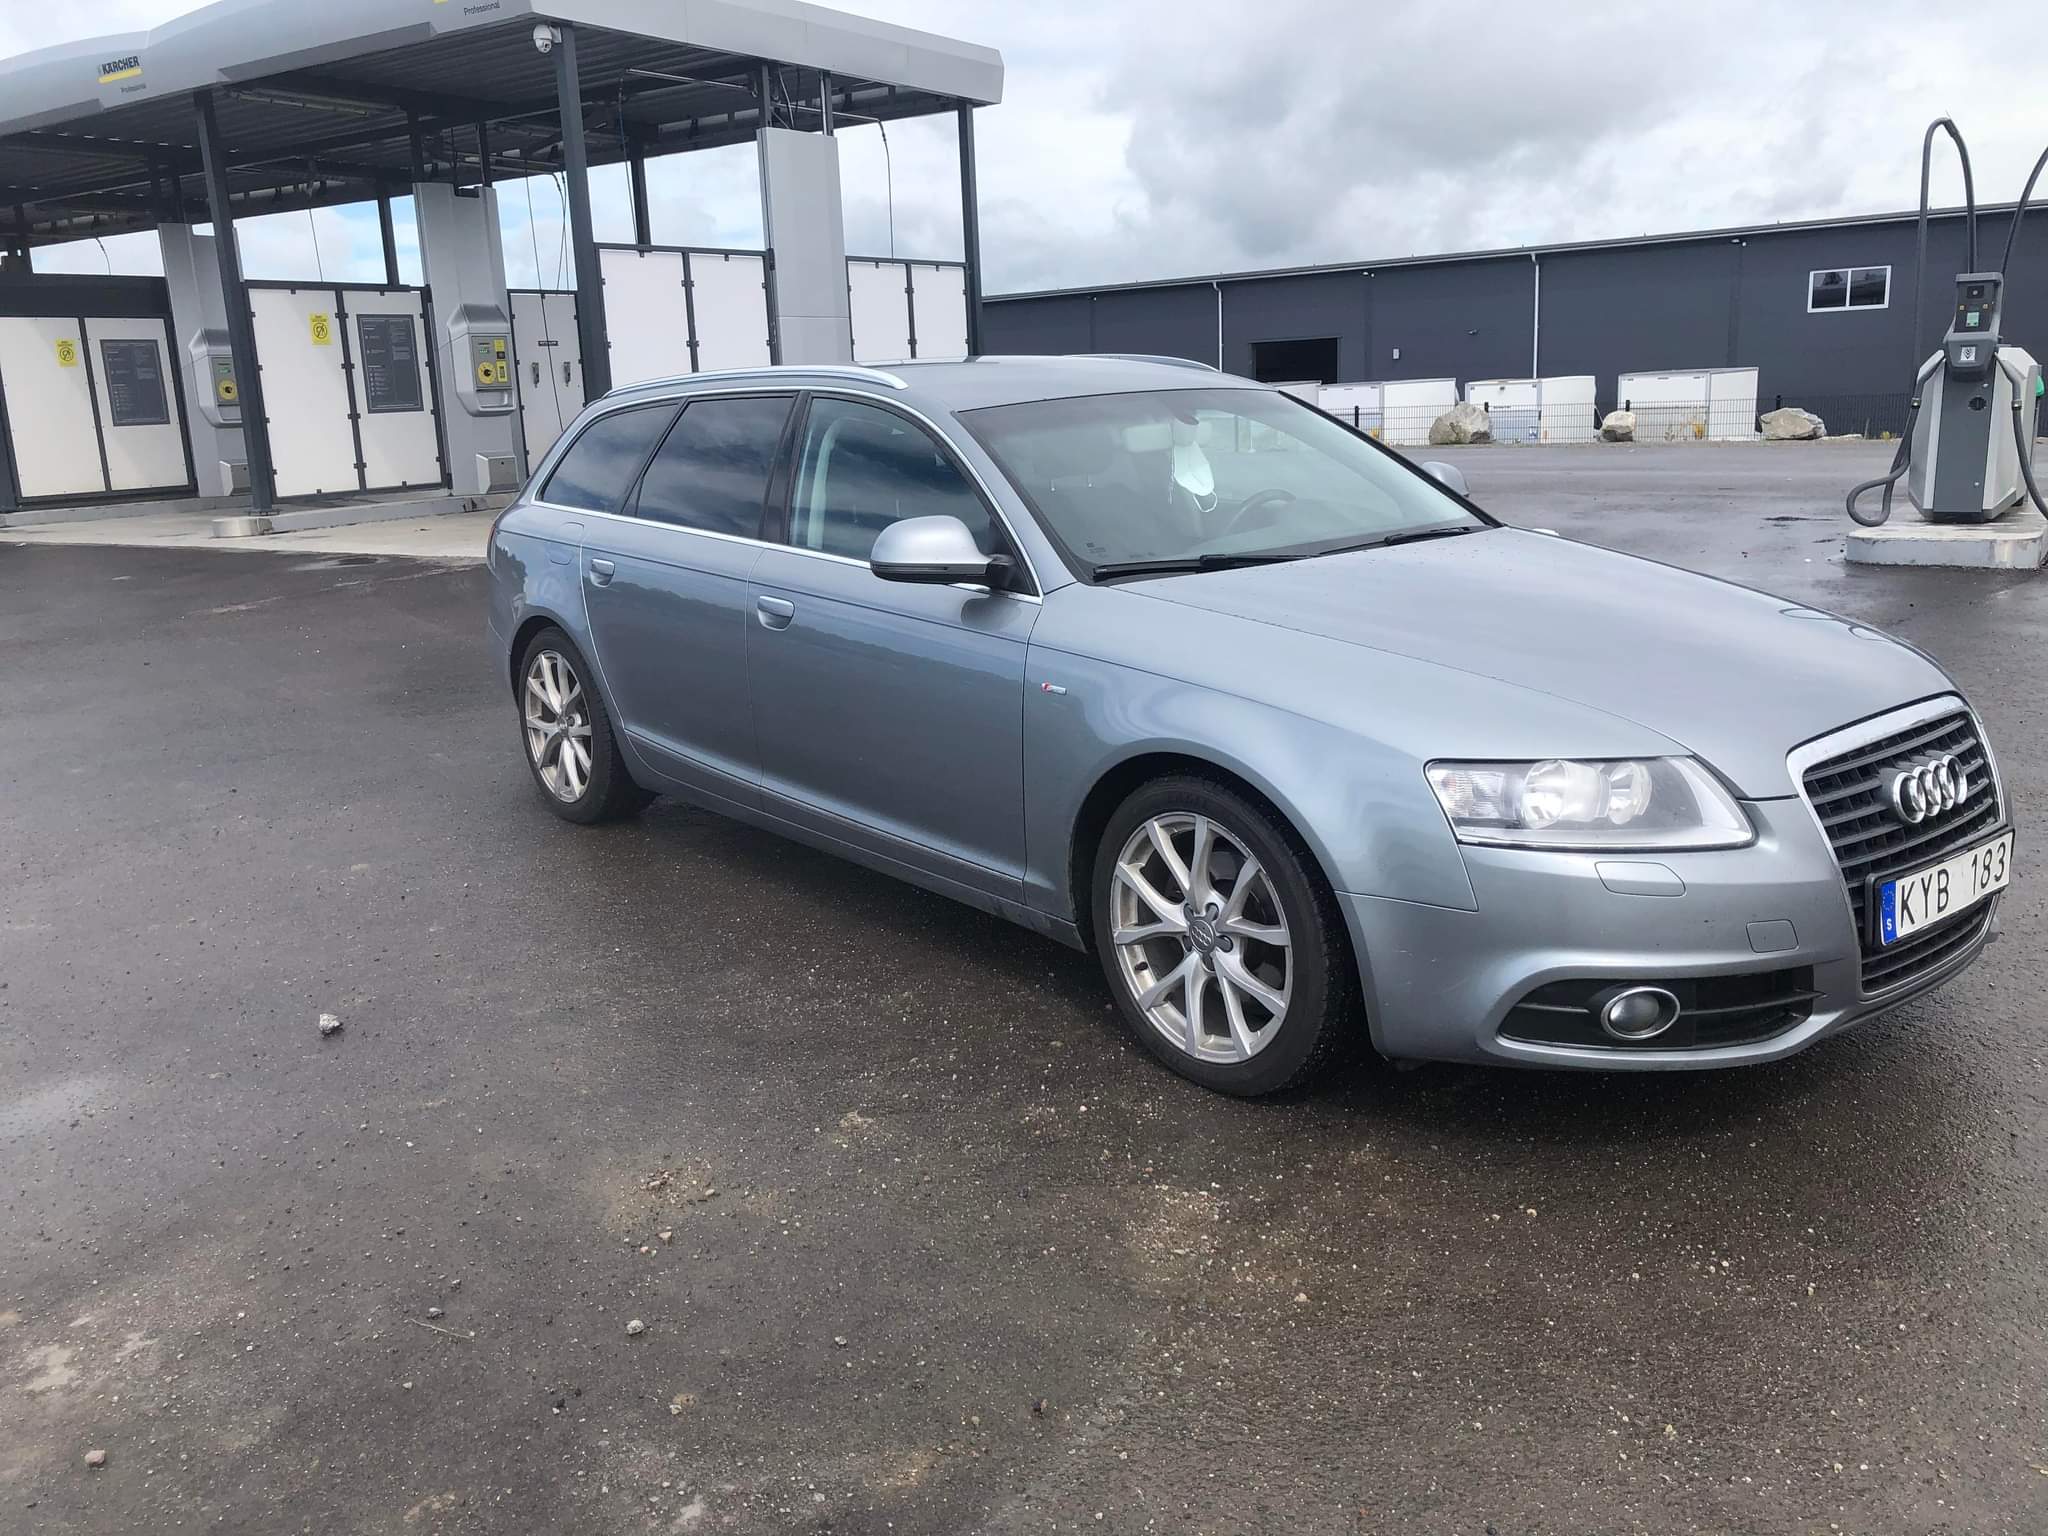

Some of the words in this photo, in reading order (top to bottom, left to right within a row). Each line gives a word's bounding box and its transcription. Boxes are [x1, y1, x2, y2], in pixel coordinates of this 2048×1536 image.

[463, 0, 501, 16] Professional
[1901, 868, 1950, 928] KYB
[1971, 841, 2007, 896] 183
[1886, 918, 1893, 931] S
